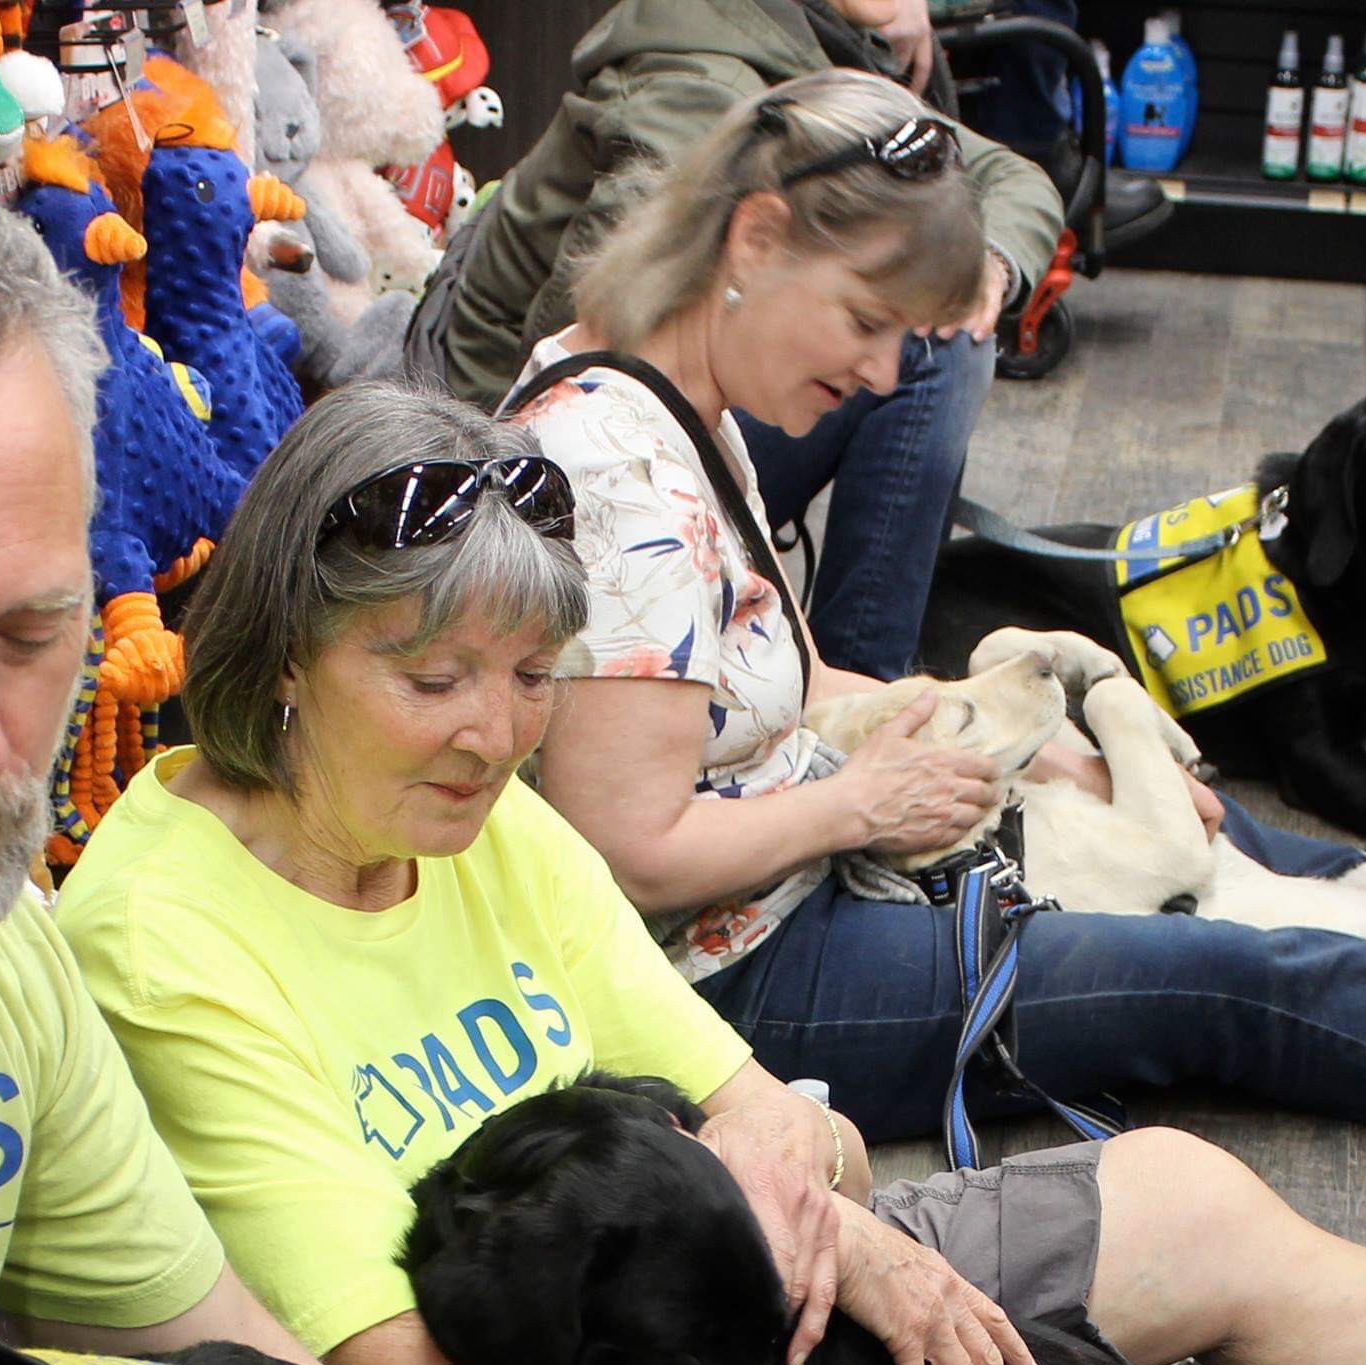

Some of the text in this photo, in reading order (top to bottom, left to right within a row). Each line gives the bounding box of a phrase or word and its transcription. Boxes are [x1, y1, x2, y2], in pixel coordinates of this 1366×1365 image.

[1186, 575, 1293, 653] PADS
[1267, 633, 1313, 667] DOG
[392, 961, 572, 1133] PADS
